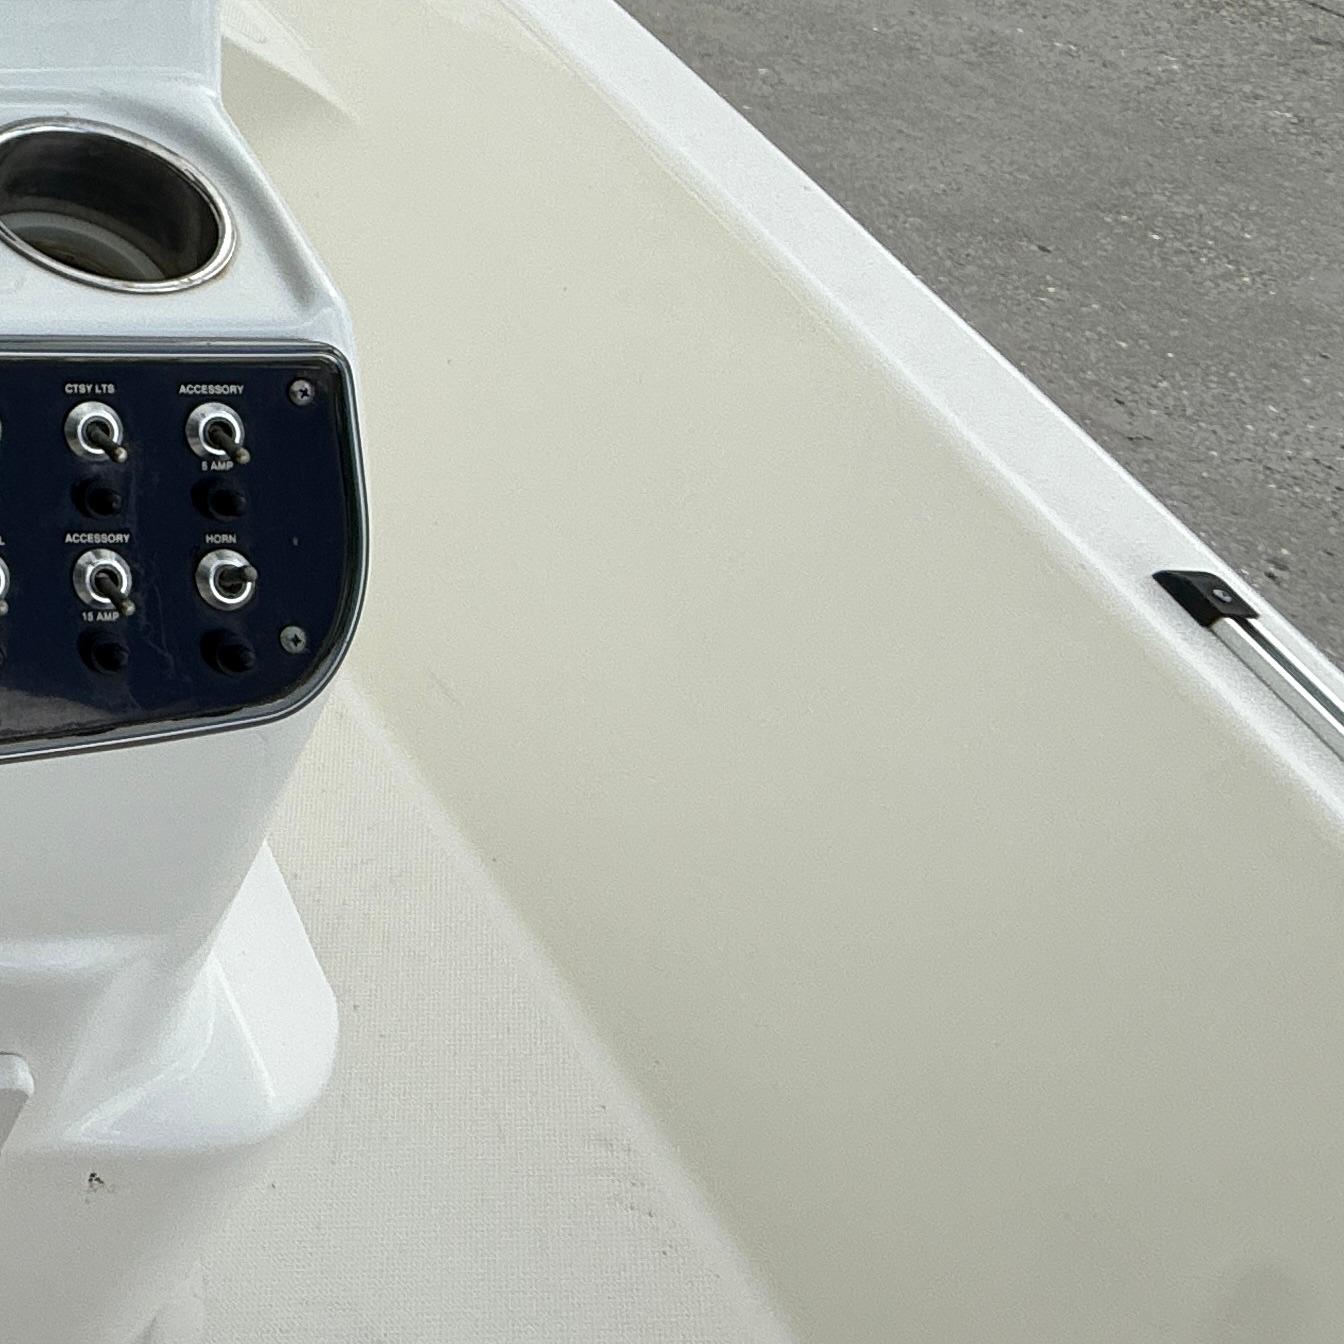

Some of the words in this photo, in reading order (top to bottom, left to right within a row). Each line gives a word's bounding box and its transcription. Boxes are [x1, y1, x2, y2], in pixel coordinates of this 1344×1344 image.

[64, 383, 93, 394] CTSY
[94, 383, 116, 394] LTS
[178, 384, 245, 395] ACCESSORY
[210, 461, 235, 471] AMP
[64, 533, 131, 544] ACCESSORY
[205, 534, 238, 544] HORN
[95, 611, 120, 622] AMP
